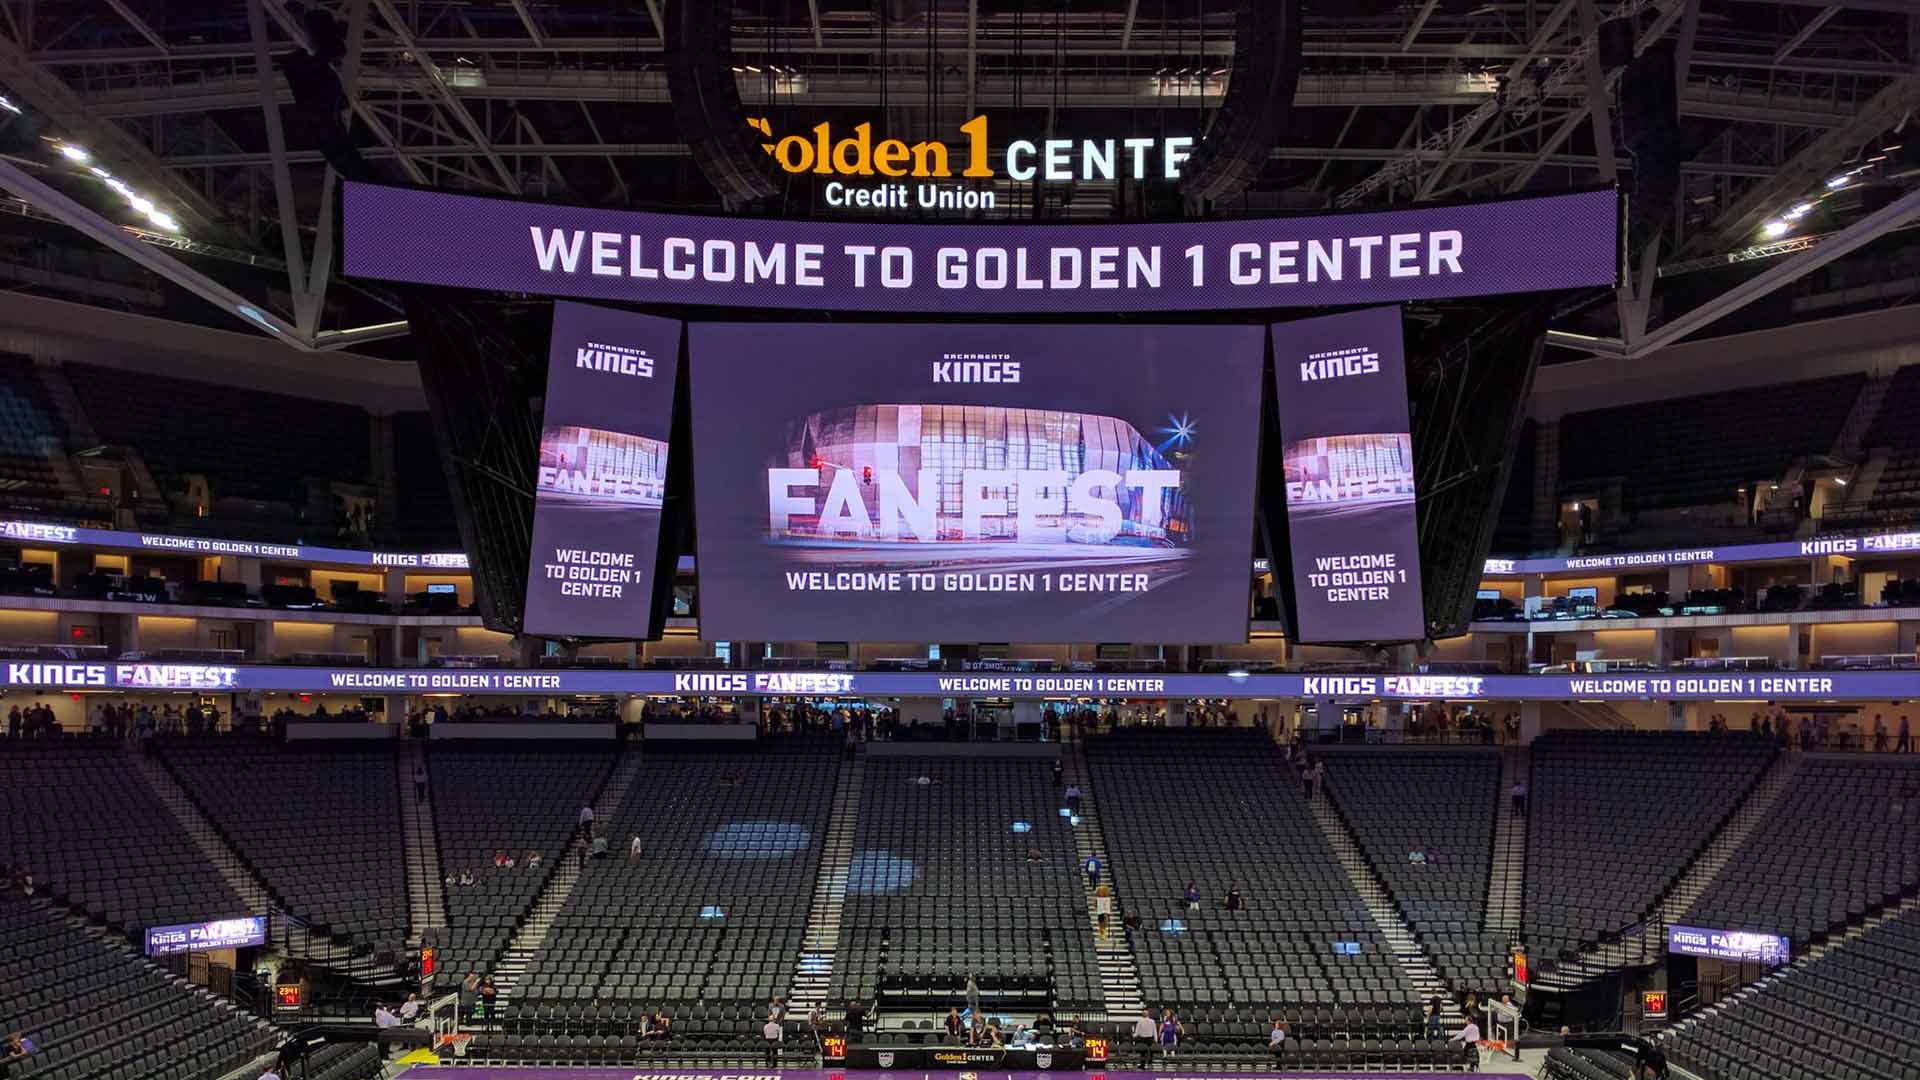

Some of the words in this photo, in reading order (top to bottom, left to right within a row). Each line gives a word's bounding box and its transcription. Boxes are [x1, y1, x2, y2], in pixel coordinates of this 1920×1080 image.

[746, 117, 952, 177] olden
[960, 114, 995, 178] 1
[1006, 137, 1193, 181] CENTE
[825, 182, 908, 208] Credit
[917, 184, 996, 209] Union
[530, 226, 825, 287] WELCOME
[844, 246, 913, 288] TO
[936, 246, 1161, 290] GOLDEN
[1185, 245, 1204, 287] 1
[1229, 230, 1464, 286] CENTER
[576, 348, 654, 378] KINGS
[933, 361, 1020, 383] KINGS
[1300, 352, 1379, 382] KINGS
[769, 468, 937, 544] FAN
[963, 469, 1181, 545] FEST
[142, 536, 194, 549] WELCOME
[196, 540, 210, 550] TO
[212, 542, 252, 553] GOLDEN
[254, 545, 259, 554] 1
[261, 546, 299, 557] CENTER
[1801, 539, 1857, 555] KINGS
[372, 553, 417, 566] KINGS
[556, 549, 634, 568] WELCOME
[1316, 554, 1395, 571] WELCOME
[1566, 555, 1612, 568] WELCOME
[1613, 556, 1626, 566] TO
[1627, 553, 1667, 564] GOLDEN
[1668, 552, 1673, 562] 1
[1675, 549, 1714, 561] CENTER
[545, 564, 565, 579] TO
[569, 566, 630, 583] GOLDEN
[634, 570, 641, 584] 1
[786, 572, 901, 591] WELCOME
[907, 573, 936, 591] TO
[943, 573, 1034, 592] GOLDEN
[1042, 574, 1051, 591] 1
[1059, 574, 1149, 592] CENTER
[1308, 573, 1329, 588] TO
[1332, 570, 1395, 588] GOLDEN
[1399, 569, 1406, 583] 1
[561, 582, 622, 598] CENTER
[1327, 586, 1389, 602] CENTER
[9, 664, 105, 685] KINGS
[116, 665, 168, 685] FAN
[176, 666, 237, 686] FEST
[331, 673, 405, 687] WELCOME
[409, 674, 428, 687] TO
[431, 675, 489, 688] GOLDEN
[493, 676, 499, 688] 1
[504, 675, 560, 688] CENTER
[675, 674, 747, 692] KINGS
[939, 678, 1010, 691] WELCOME
[1014, 679, 1032, 691] TO
[1036, 679, 1093, 692] GOLDEN
[1097, 679, 1103, 692] 1
[1107, 679, 1164, 692] CENTER
[1304, 677, 1376, 695] KINGS
[1570, 680, 1647, 693] WELCOME
[1650, 679, 1671, 693] TO
[1676, 679, 1743, 693] GOLDEN
[1747, 679, 1755, 693] 1
[1761, 678, 1833, 693] CENTER
[832, 1045, 843, 1056] 14
[1092, 1046, 1104, 1057] 14
